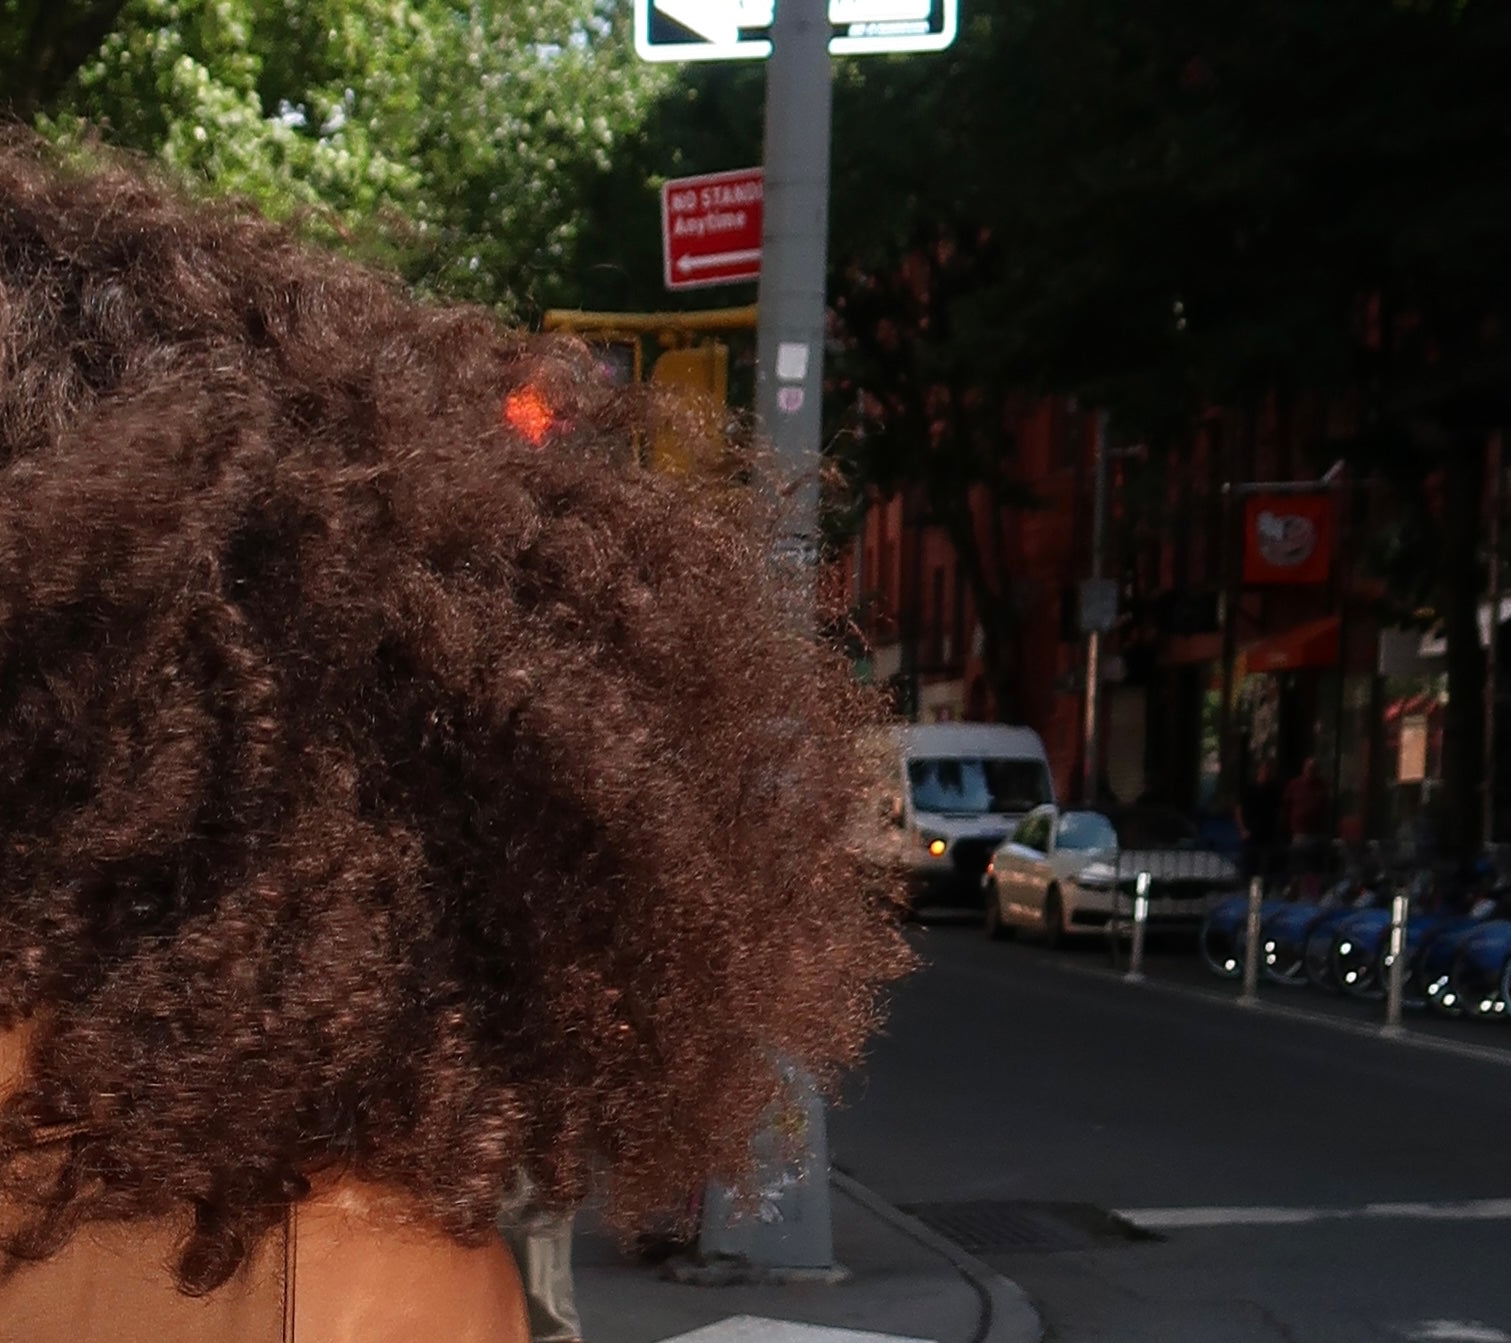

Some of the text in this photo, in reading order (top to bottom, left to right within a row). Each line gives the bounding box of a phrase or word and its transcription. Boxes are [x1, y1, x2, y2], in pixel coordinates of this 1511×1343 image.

[671, 182, 763, 212] NO STAND
[674, 210, 746, 237] Anytime
